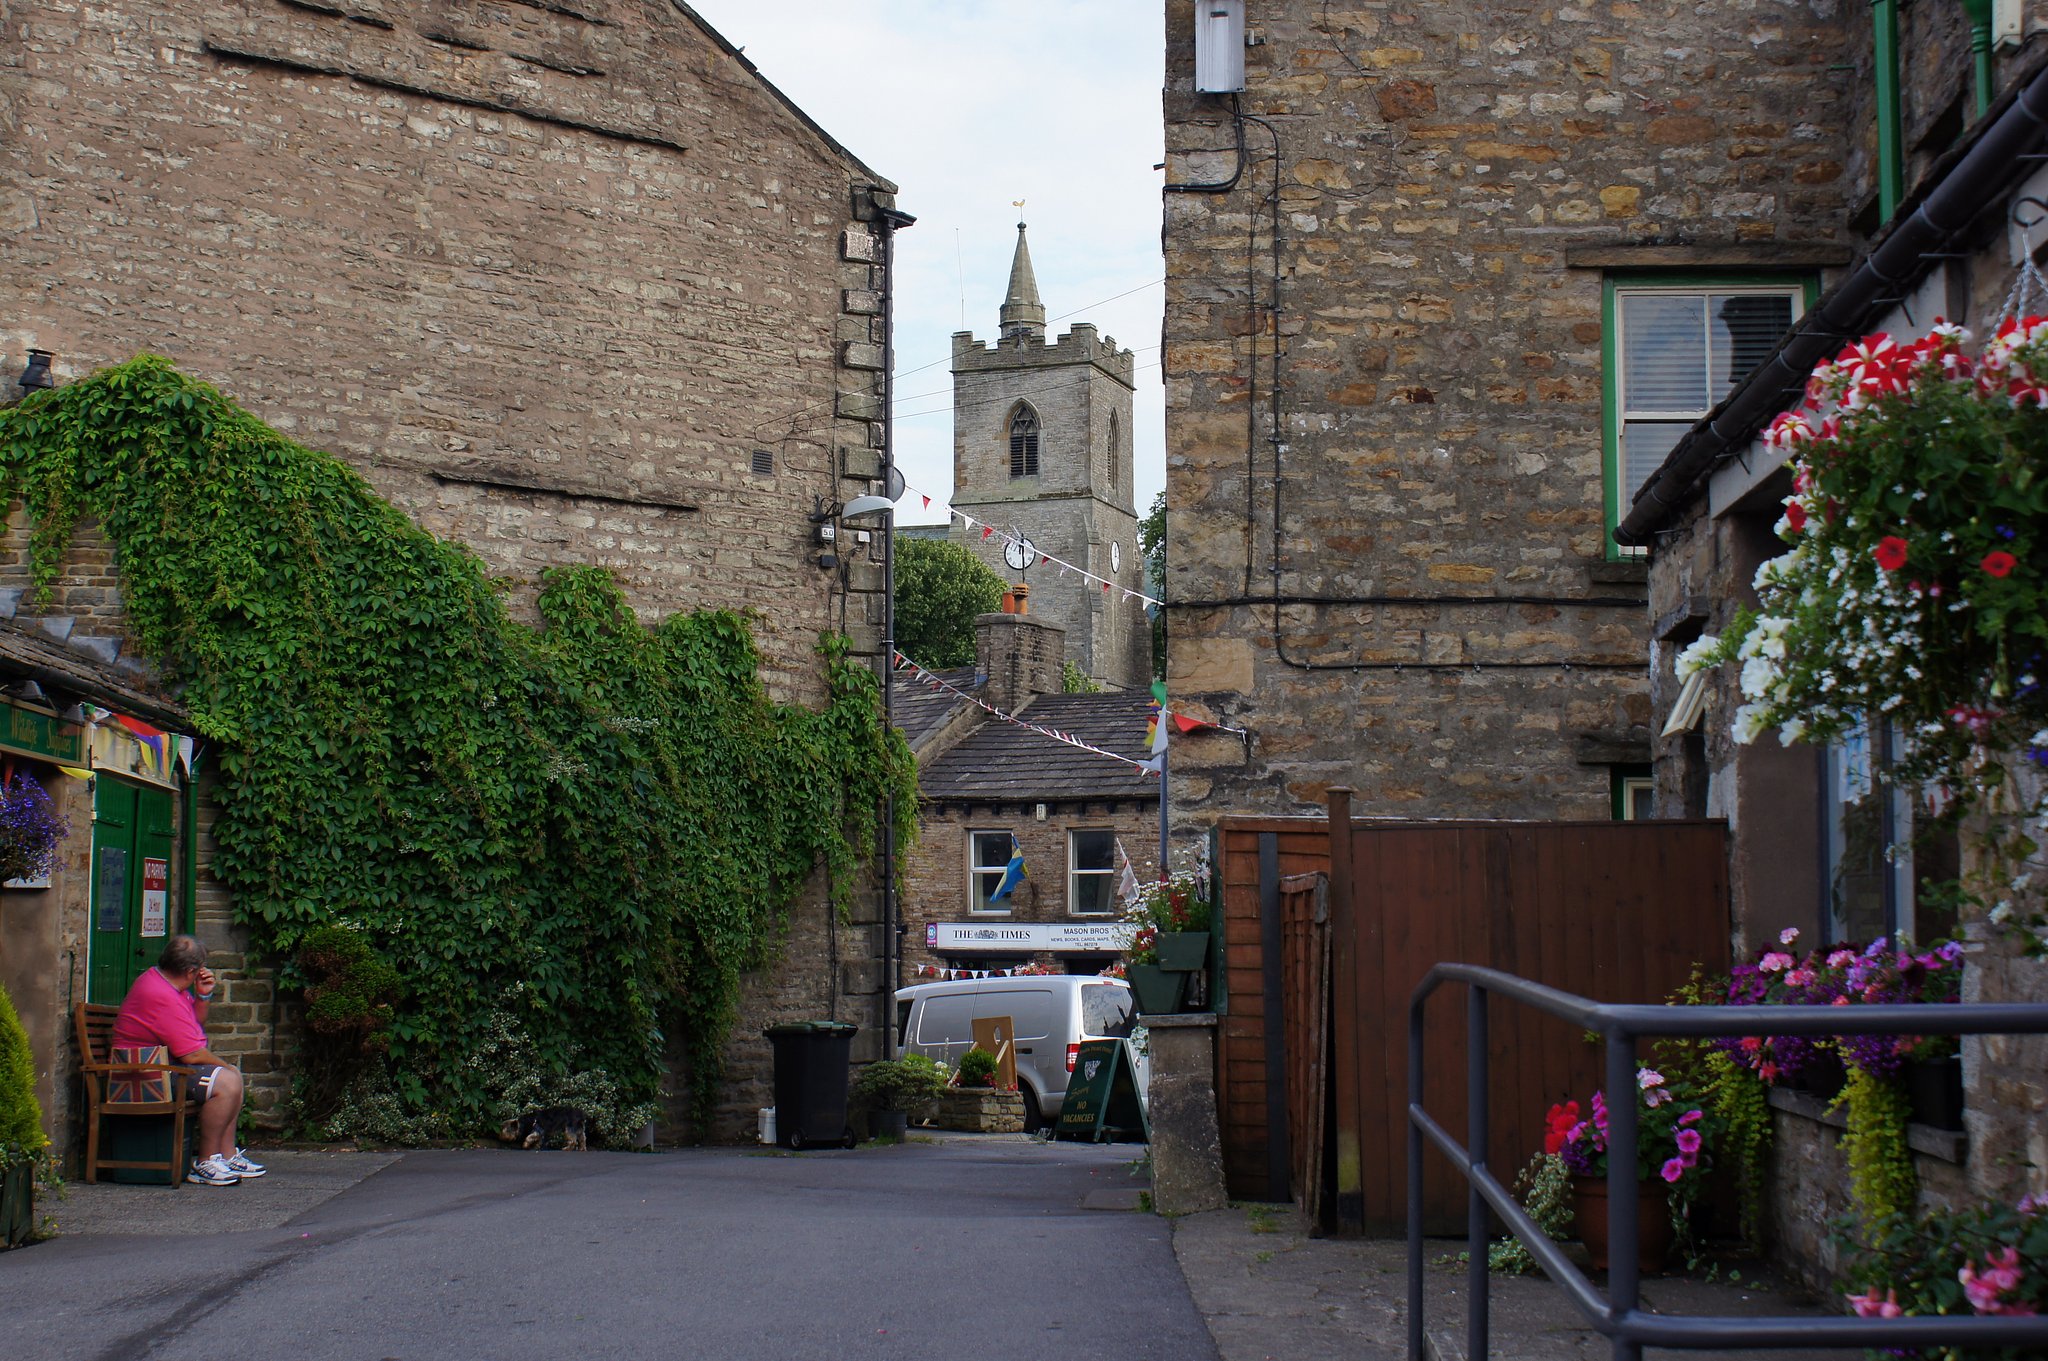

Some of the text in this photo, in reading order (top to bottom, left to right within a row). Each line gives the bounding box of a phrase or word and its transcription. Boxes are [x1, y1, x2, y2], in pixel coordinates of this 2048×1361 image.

[953, 930, 1031, 940] THE TIMES
[1063, 927, 1109, 935] MASON BROS
[1076, 1101, 1087, 1110] NO
[1063, 1113, 1095, 1123] VACANCIES
